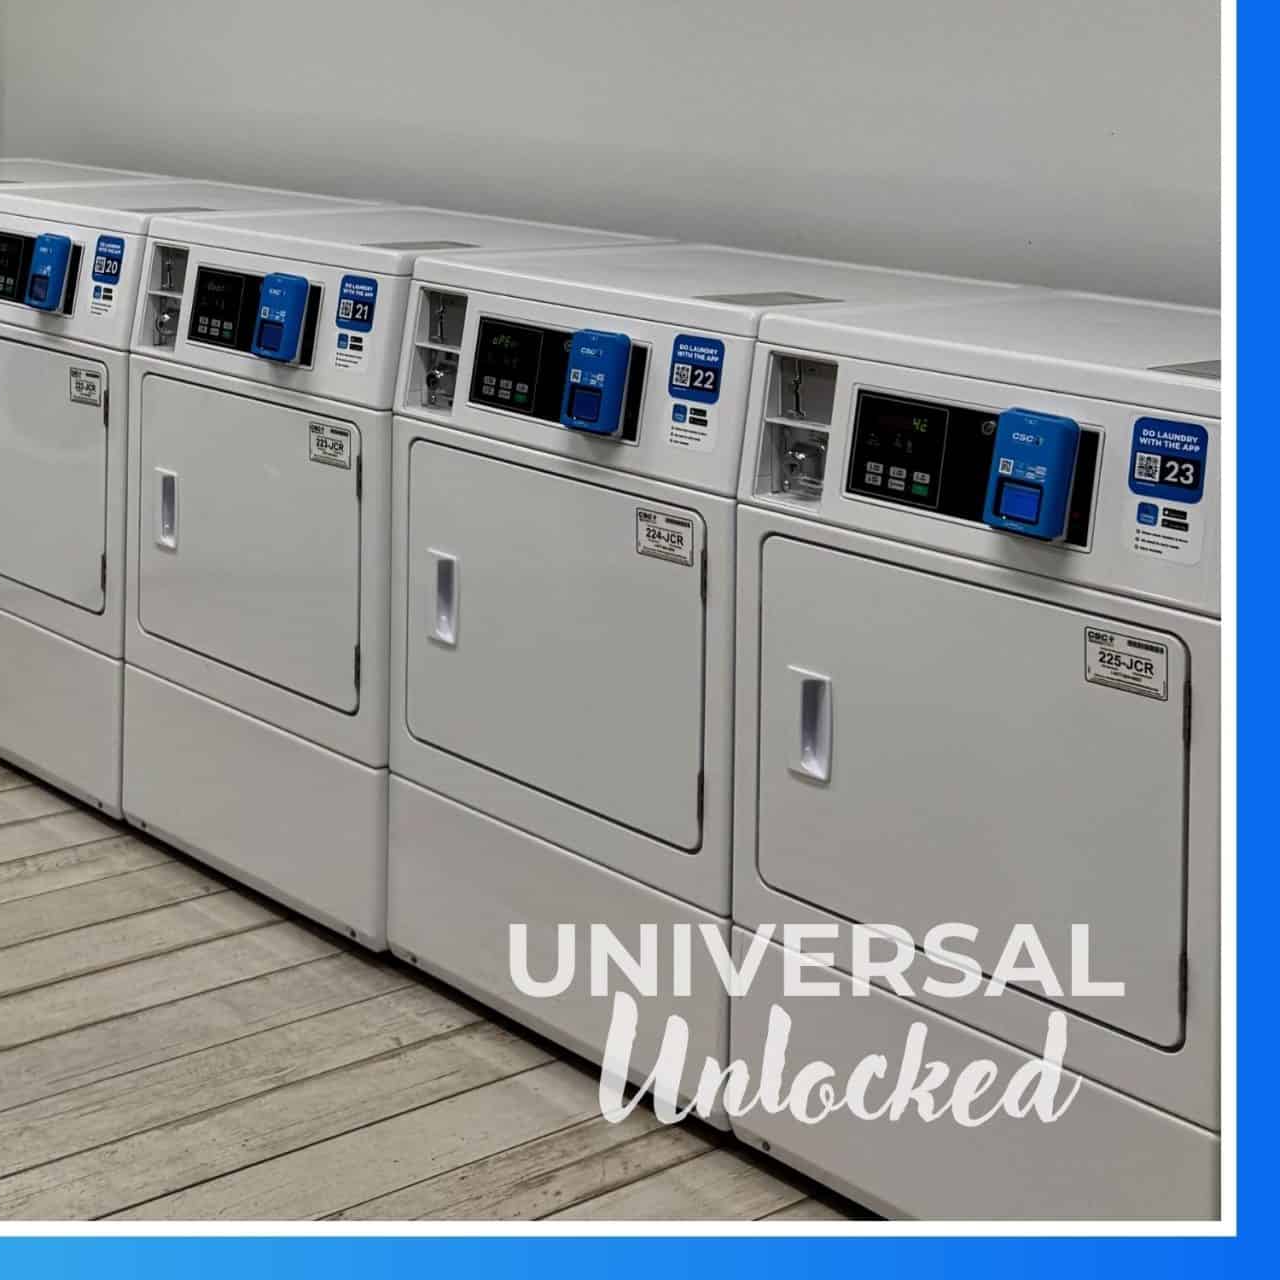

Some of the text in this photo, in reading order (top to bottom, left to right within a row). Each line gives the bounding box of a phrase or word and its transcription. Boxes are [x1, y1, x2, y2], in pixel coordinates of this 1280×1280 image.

[105, 260, 118, 274] 20
[355, 304, 368, 320] 21
[693, 369, 715, 388] 22
[1012, 432, 1034, 442] CSC
[1139, 436, 1200, 452] WITH THE APP
[1142, 428, 1198, 444] DO LAUNDRY
[1164, 460, 1195, 485] 23
[646, 528, 684, 546] 224-JCR
[1098, 650, 1154, 676] 225-JCR
